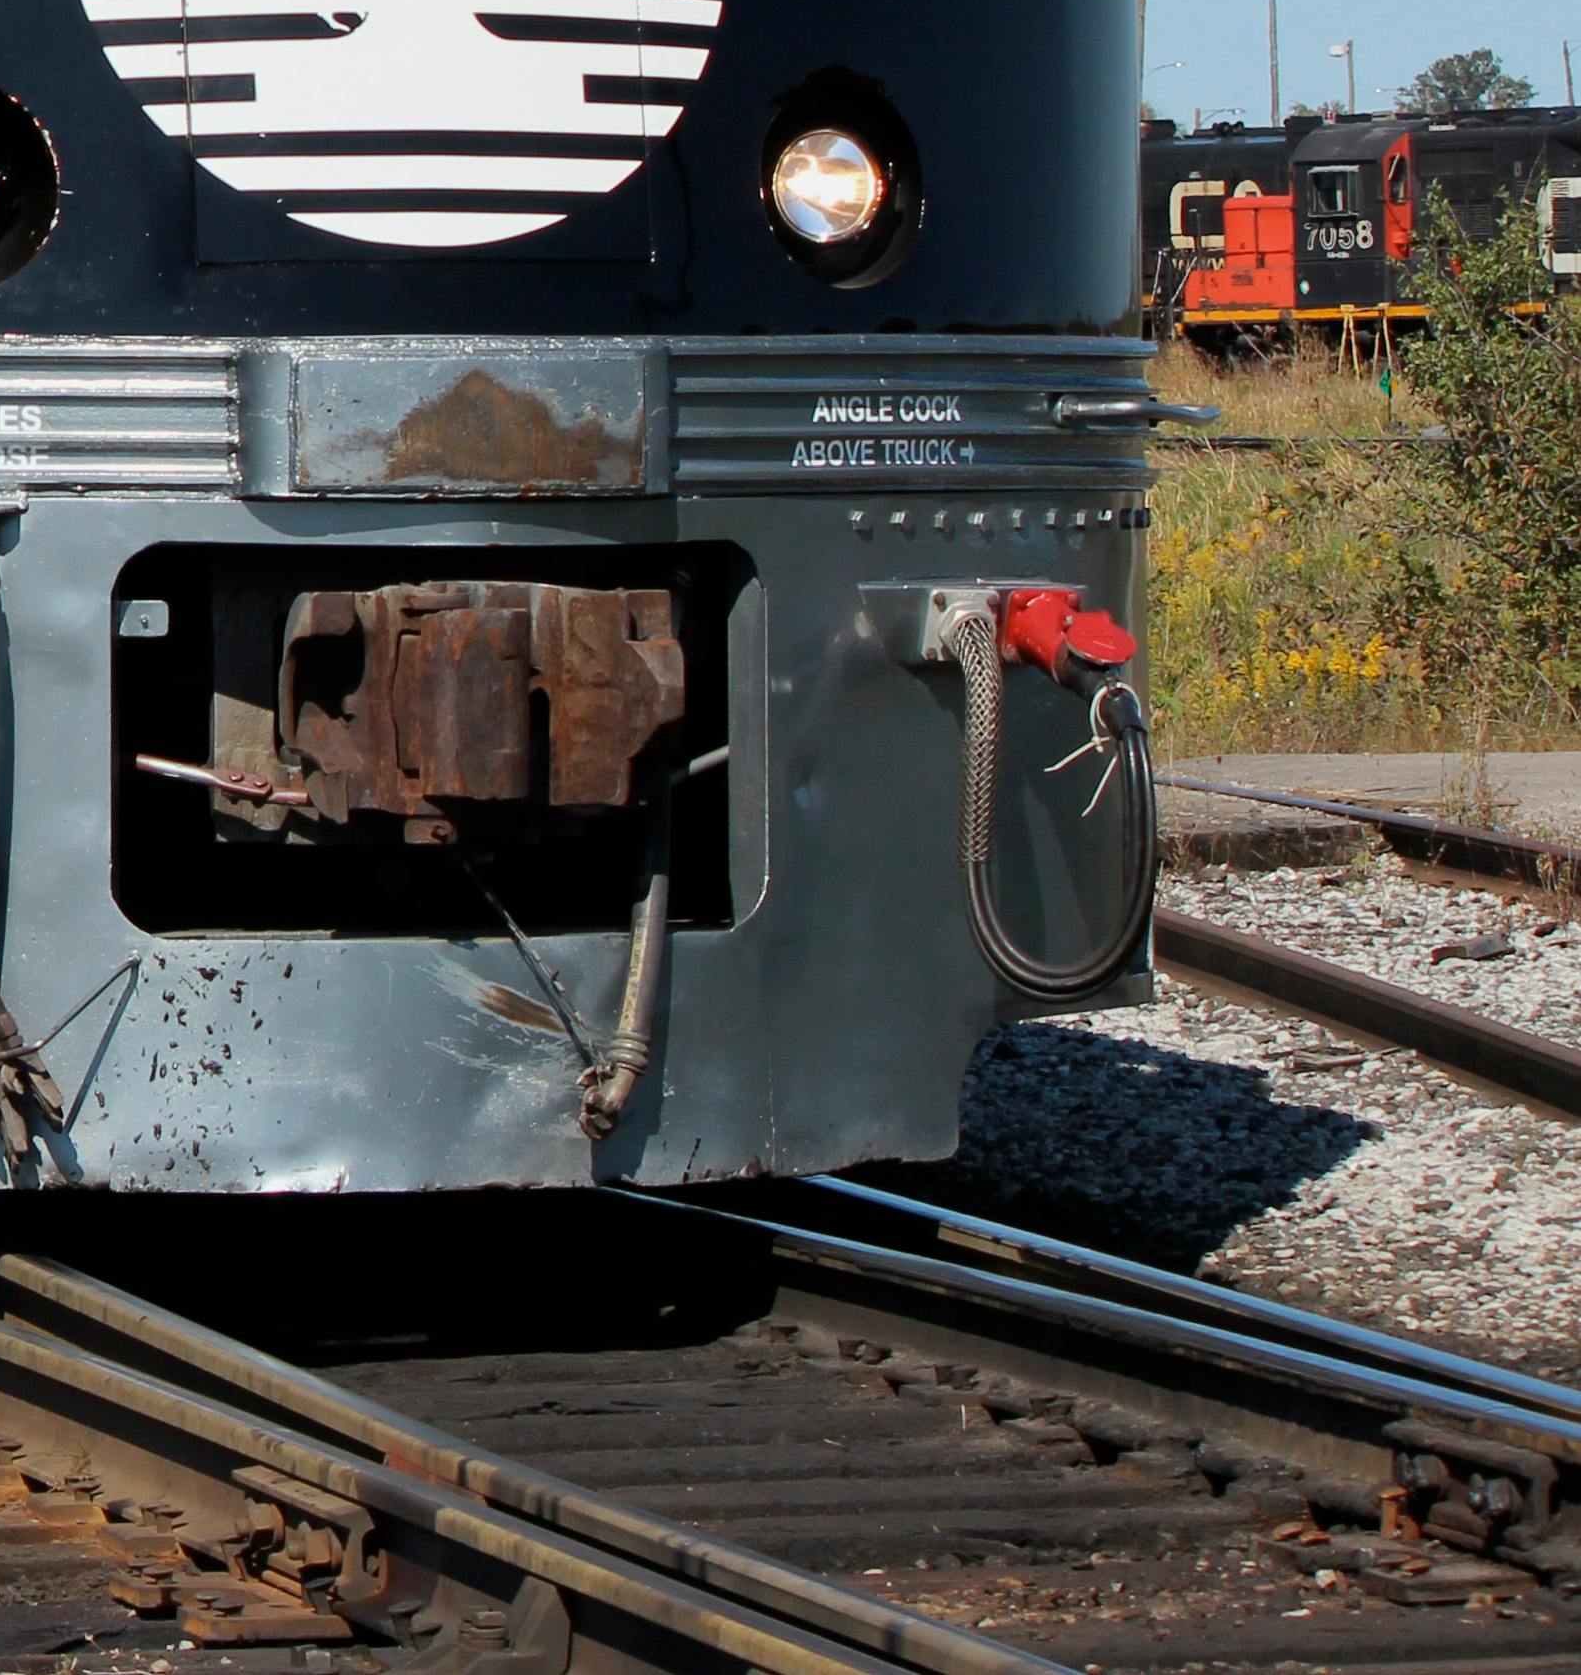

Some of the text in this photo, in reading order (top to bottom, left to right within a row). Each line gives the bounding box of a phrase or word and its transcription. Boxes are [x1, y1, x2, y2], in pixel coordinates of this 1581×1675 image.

[1304, 220, 1375, 250] 7058
[812, 395, 962, 423] ANGLE COCK
[790, 439, 957, 467] ABOVE TRUCK
